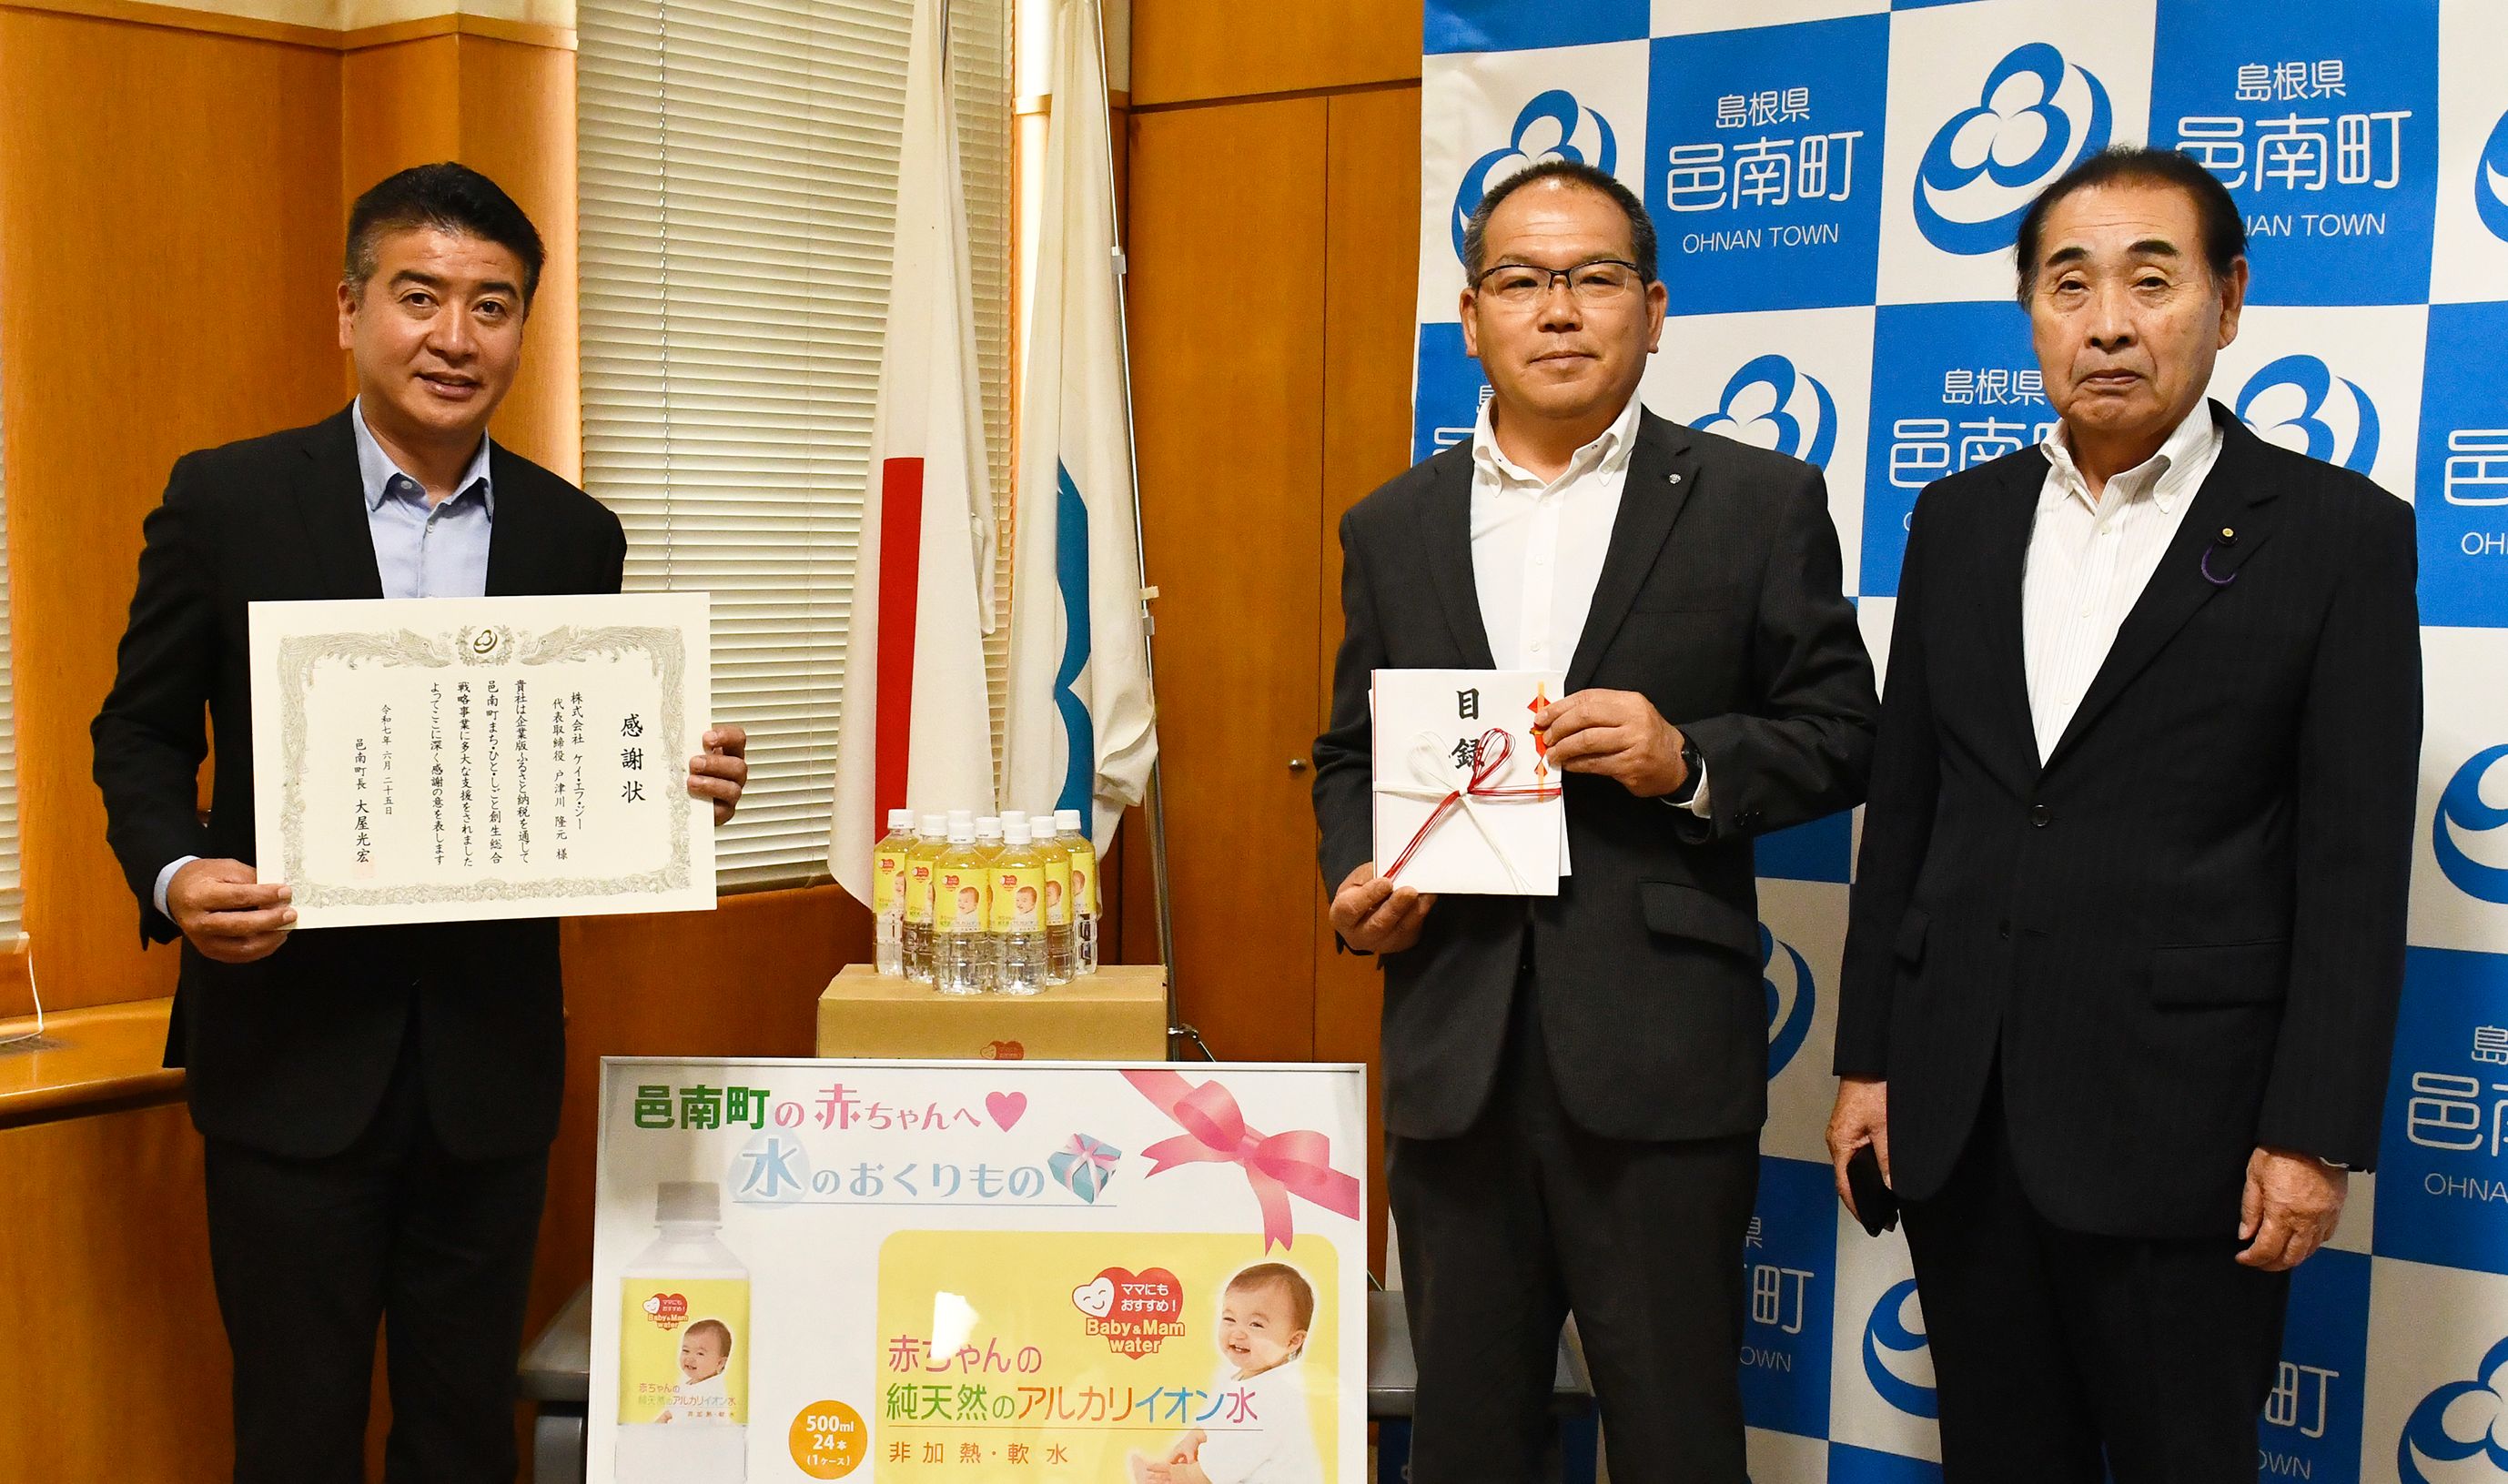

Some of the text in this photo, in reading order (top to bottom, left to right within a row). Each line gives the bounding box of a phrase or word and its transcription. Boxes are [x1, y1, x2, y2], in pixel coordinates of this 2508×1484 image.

[1715, 86, 1811, 128] 島根県
[2235, 59, 2347, 102] 島根県
[1666, 130, 1865, 212] 邑南町
[2175, 110, 2412, 192] 邑南町
[1684, 223, 1839, 254] OHNAN TOWN
[2245, 213, 2387, 237] AN TOWN
[1942, 368, 2046, 407] 島根県
[1888, 416, 2057, 489] 邑南
[2461, 530, 2508, 556] OH
[380, 703, 394, 815] 令和七年 六月 二十五日
[551, 697, 566, 762] 代表取締役
[620, 712, 646, 804] 感謝状
[1449, 687, 1485, 771] 目録
[354, 738, 367, 791] 邑南町長
[430, 681, 445, 867] よってここに深く感謝の意を表します
[457, 681, 474, 868] 戦略事業に多大な支援をされました
[485, 680, 503, 865] 邑南町まち・ひと・しごと創生総合
[514, 679, 531, 864] 貴社は企業版ふるさと納税を通して
[570, 692, 586, 831] 株式会社 ケイ・エフ・ジー
[354, 799, 371, 863] 大屋光宏
[554, 815, 568, 841] 隆元
[555, 847, 569, 861] 様
[634, 1084, 983, 1131] 邑南町の赤ちゃんへ
[2407, 1071, 2508, 1157] 邑
[740, 1137, 1046, 1198] 水のおくりもの
[1120, 1282, 1169, 1297] ママにも
[1744, 1264, 1815, 1335] 町
[1109, 1337, 1162, 1354] water
[806, 1415, 855, 1432] 500ml
[886, 1382, 1259, 1425] 純天然のアルカリイオン水
